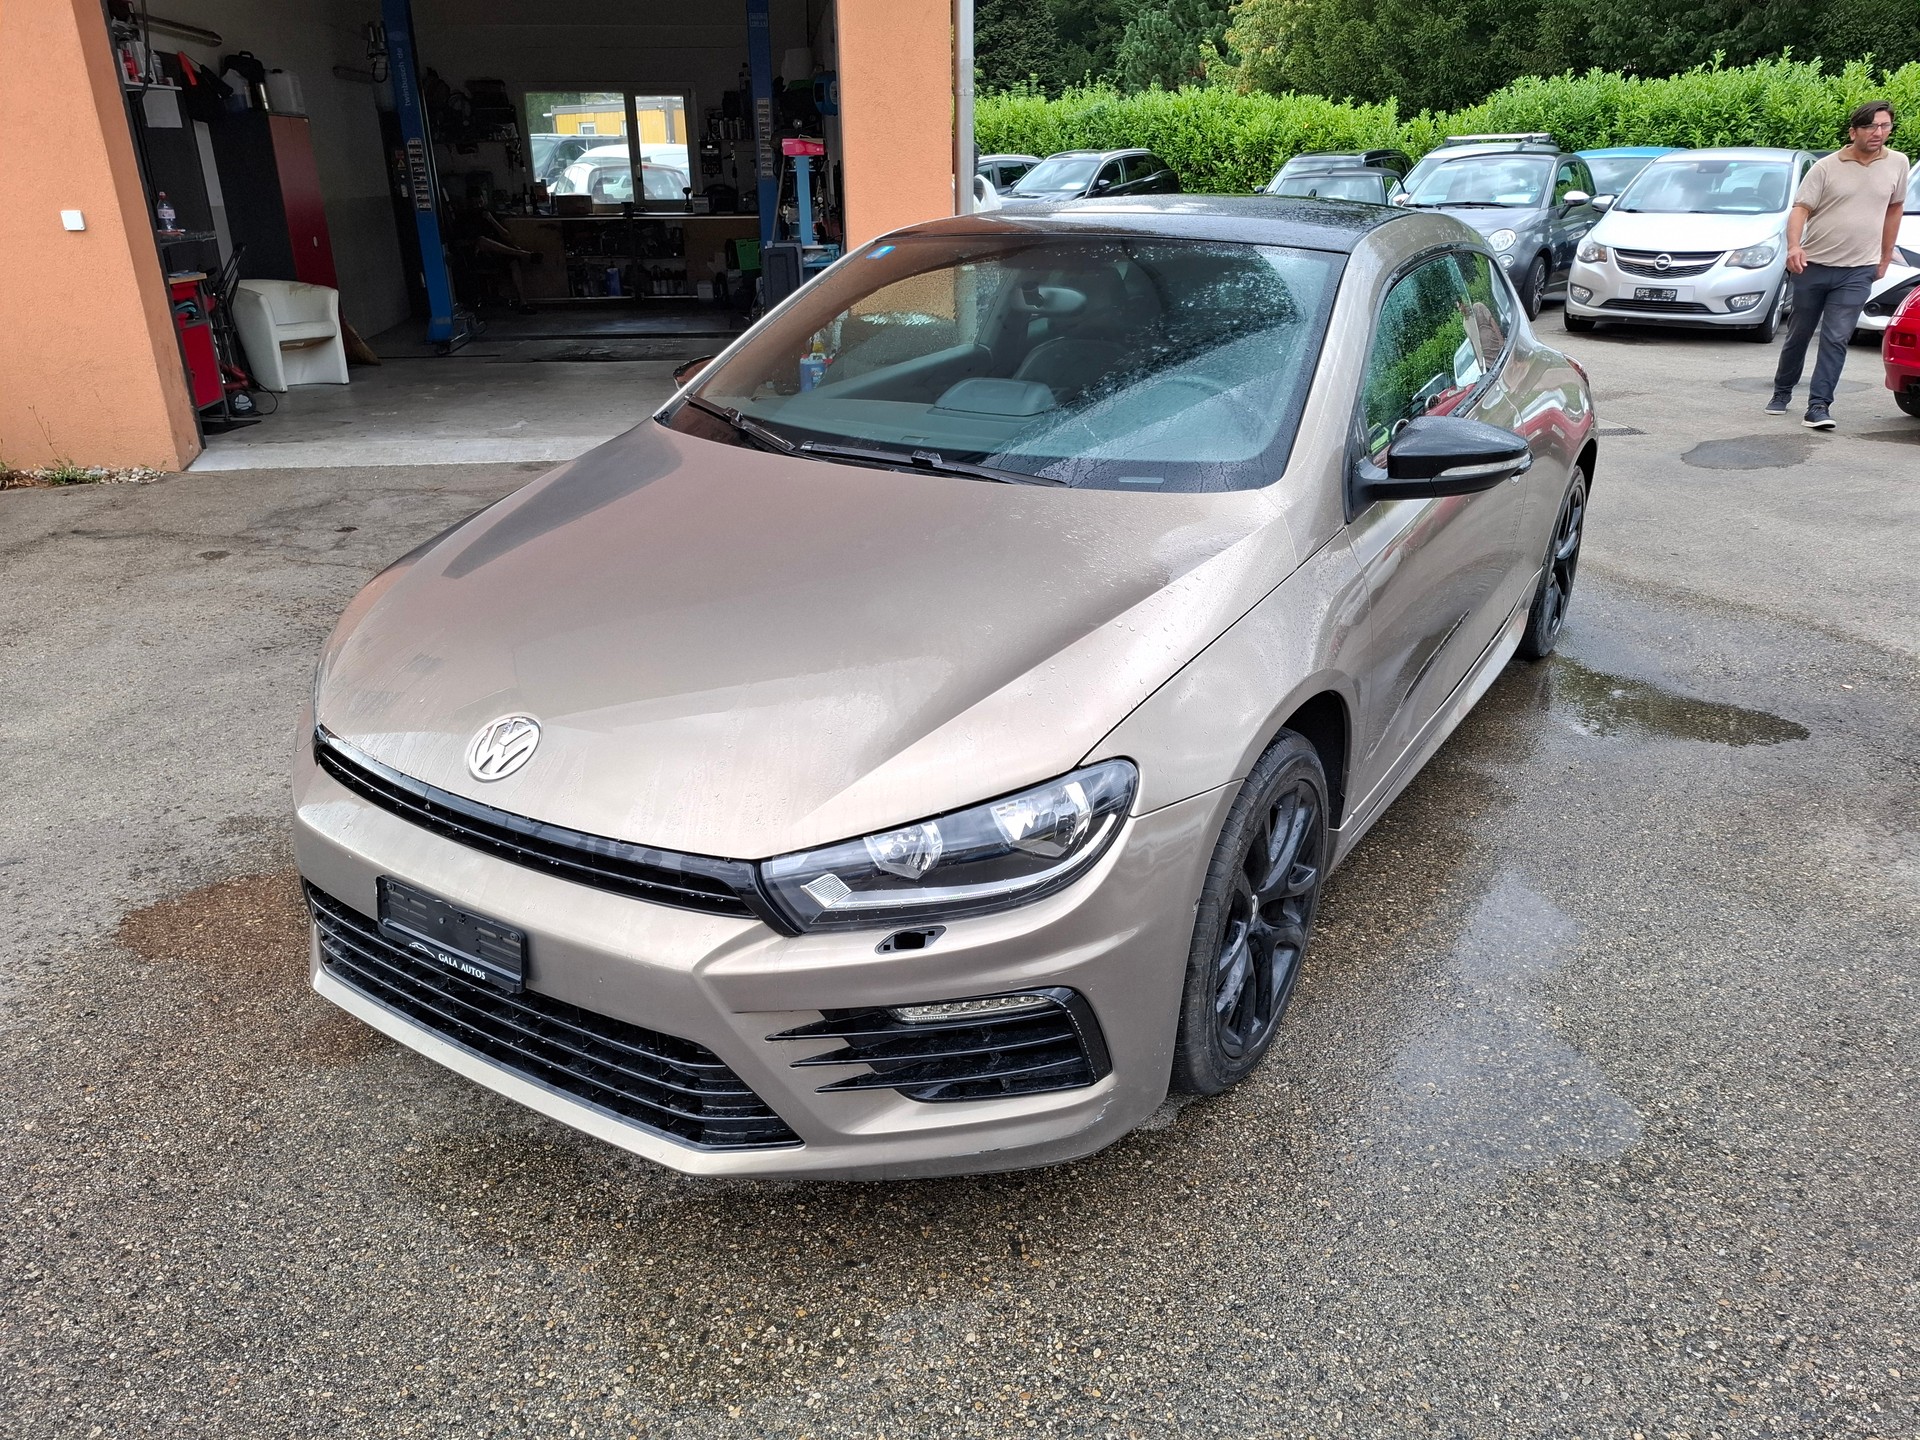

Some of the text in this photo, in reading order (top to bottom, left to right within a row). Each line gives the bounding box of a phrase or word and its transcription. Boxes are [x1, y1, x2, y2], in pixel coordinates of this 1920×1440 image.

[396, 47, 411, 106] twinbuschde
[438, 953, 486, 980] GALA AUTOS
